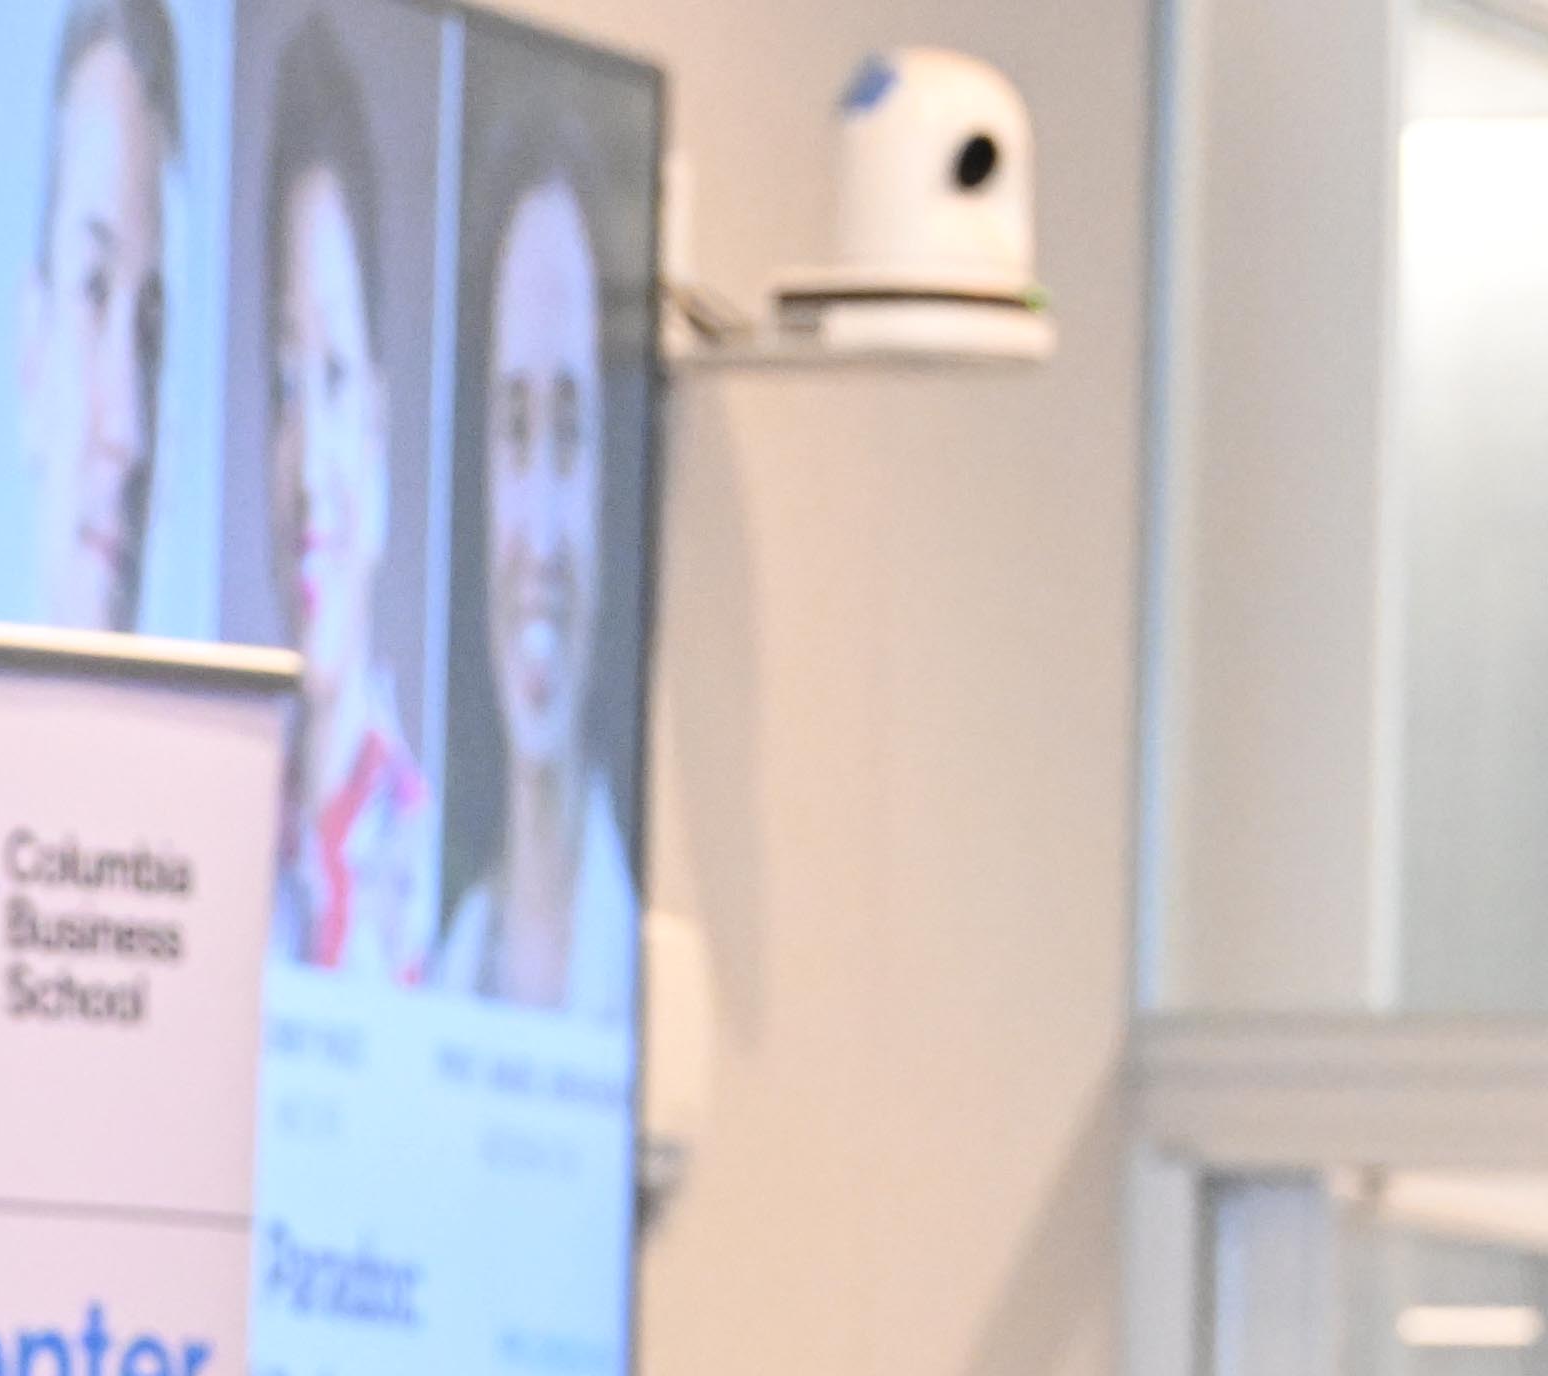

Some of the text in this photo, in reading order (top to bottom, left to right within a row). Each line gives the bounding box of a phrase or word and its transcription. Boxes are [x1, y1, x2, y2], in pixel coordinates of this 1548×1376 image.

[3, 827, 196, 898] Columbia
[4, 894, 185, 964] Business
[4, 958, 151, 1028] School
